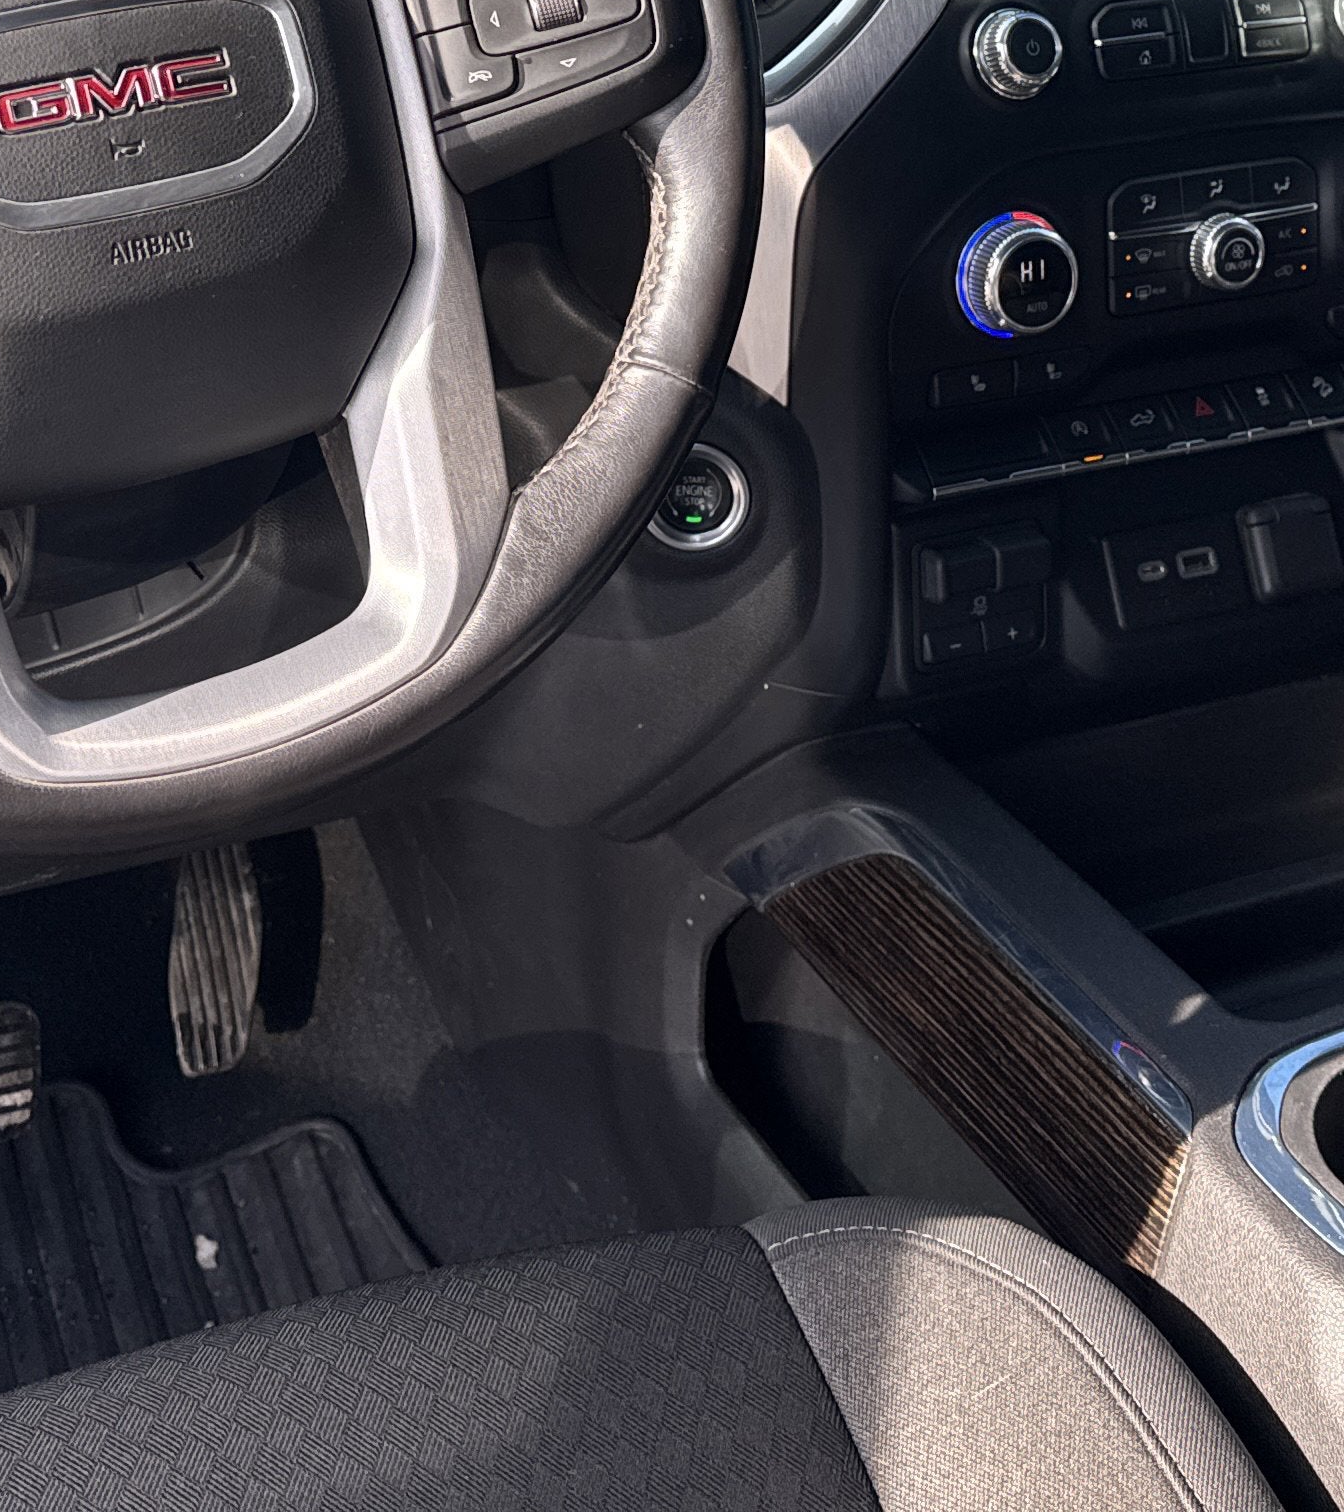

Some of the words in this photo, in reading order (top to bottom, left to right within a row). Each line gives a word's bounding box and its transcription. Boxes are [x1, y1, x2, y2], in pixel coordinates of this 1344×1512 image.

[110, 229, 194, 265] AIRBAG
[1020, 258, 1045, 283] HI
[1224, 259, 1253, 272] ON/OFF
[1027, 301, 1048, 313] AUTO
[683, 476, 707, 485] START
[676, 484, 714, 498] ENGINE
[685, 497, 705, 506] STOP
